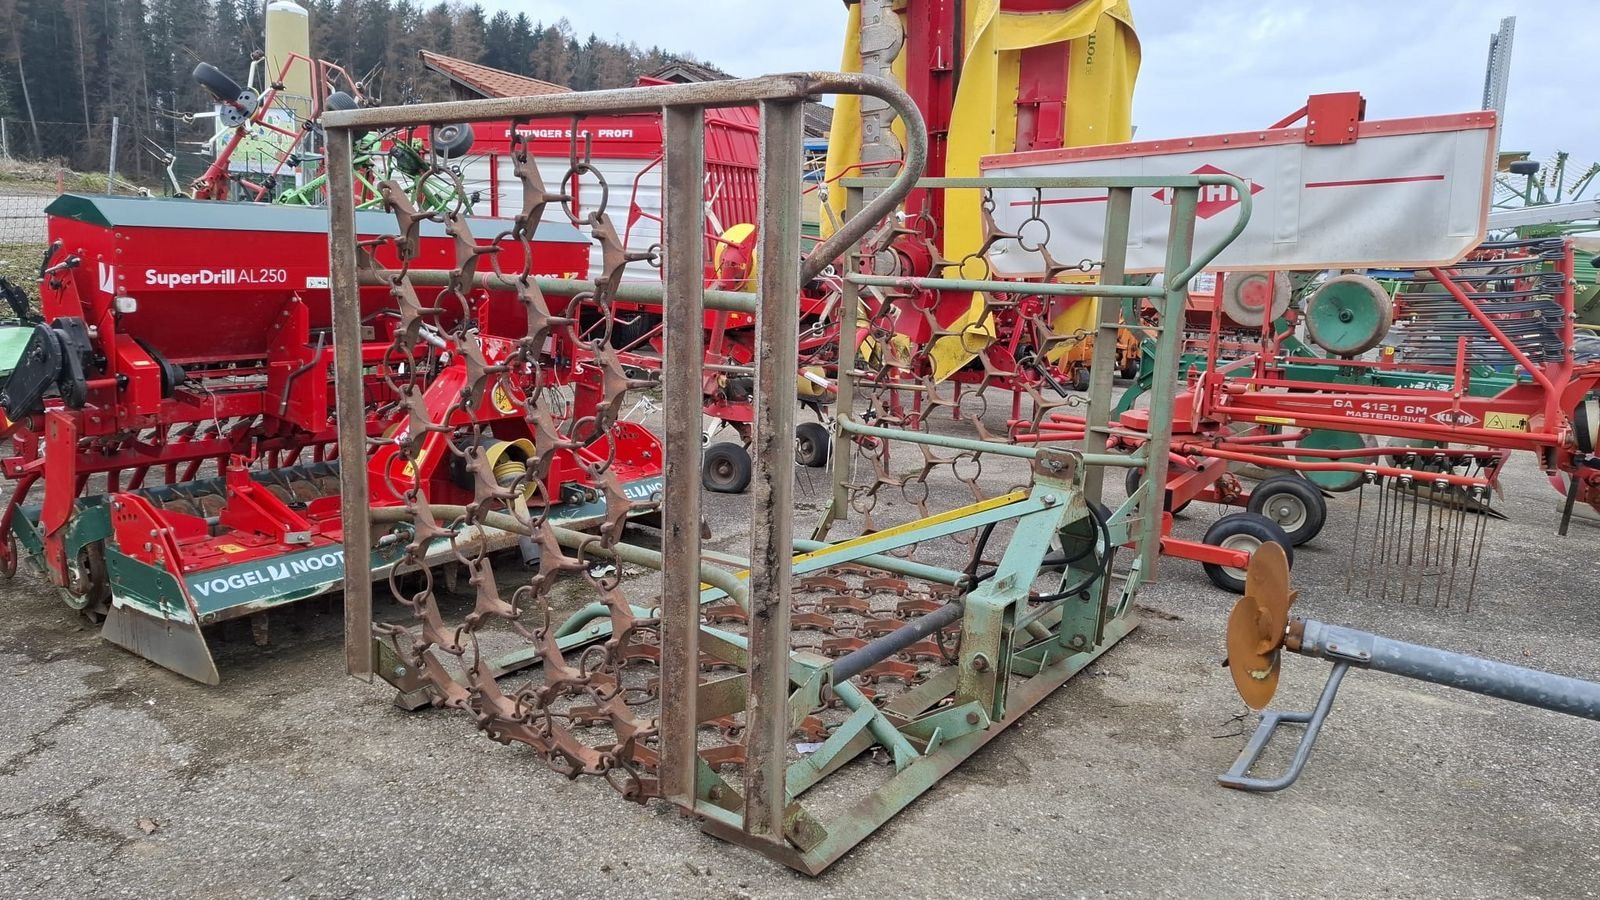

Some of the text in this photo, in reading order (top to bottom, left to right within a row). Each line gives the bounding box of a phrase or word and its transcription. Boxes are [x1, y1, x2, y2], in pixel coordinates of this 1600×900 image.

[597, 129, 633, 138] PROFI
[1333, 399, 1428, 415] GA 4121 GM
[1346, 410, 1426, 424] MASTERDRIVE
[194, 569, 270, 597] VOGEL
